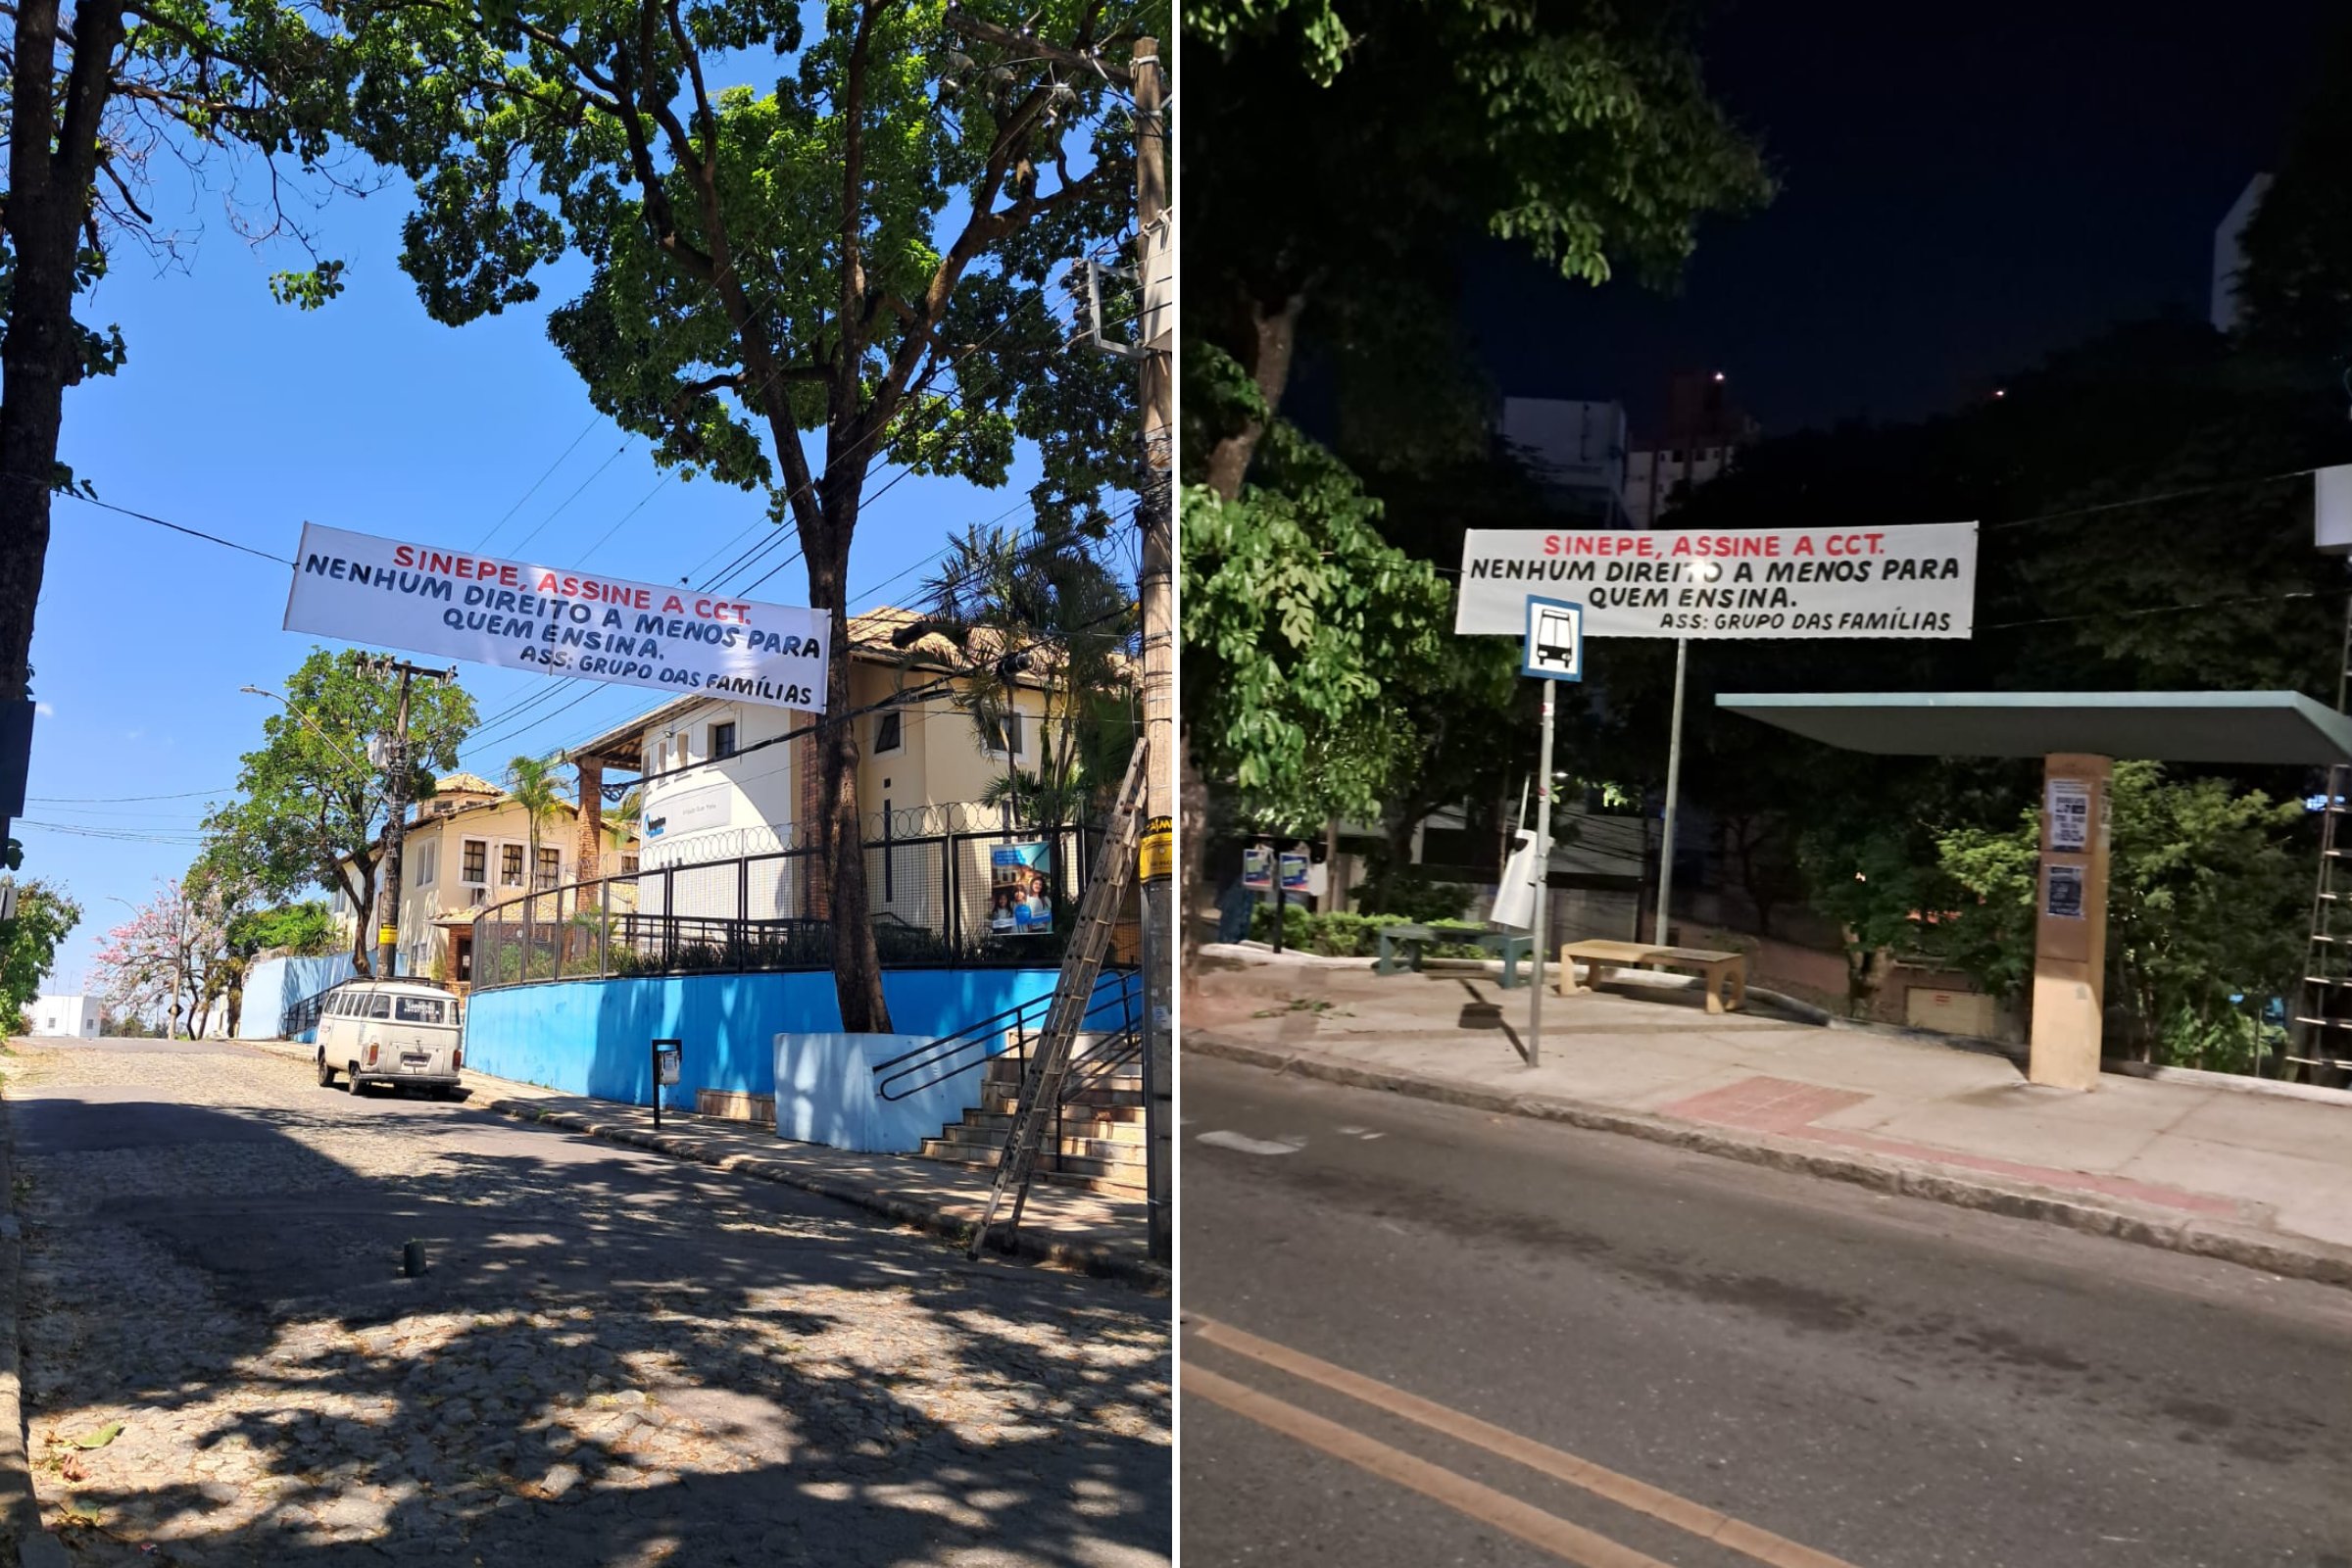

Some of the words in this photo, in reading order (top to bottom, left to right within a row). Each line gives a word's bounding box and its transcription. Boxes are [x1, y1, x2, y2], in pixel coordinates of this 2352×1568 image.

[1544, 534, 1664, 561] SINEPE,
[1671, 535, 1780, 558] ASSINE
[1793, 534, 1815, 556] A
[1826, 533, 1885, 556] CCT.
[393, 545, 527, 593] SINEPE,
[536, 569, 652, 611] ASSINE
[662, 593, 685, 615] A
[694, 599, 753, 625] CCT.
[1470, 559, 1594, 581] NENHUM
[1733, 561, 1754, 582] A
[1765, 561, 1871, 582] MENOS
[1882, 558, 1960, 581] PARA
[304, 553, 452, 602] NENHUM
[466, 584, 590, 624] DIREITO
[602, 609, 622, 628] A
[634, 613, 738, 649] MENOS
[747, 628, 821, 660] PARA
[1588, 587, 1667, 609] QUEM
[1677, 587, 1797, 609] ENSINA.
[443, 608, 534, 642] QUEM
[542, 623, 665, 661] ENSINA.
[1659, 614, 1709, 629] ASS:
[1714, 613, 1786, 630] GRUPO
[1791, 613, 1833, 631] DAS
[1838, 607, 1951, 631] FAMÍLIAS
[519, 645, 572, 672] ASS:
[579, 655, 651, 680] GRUPO
[658, 665, 701, 689] DAS
[706, 673, 812, 706] FAMÍLIAS
